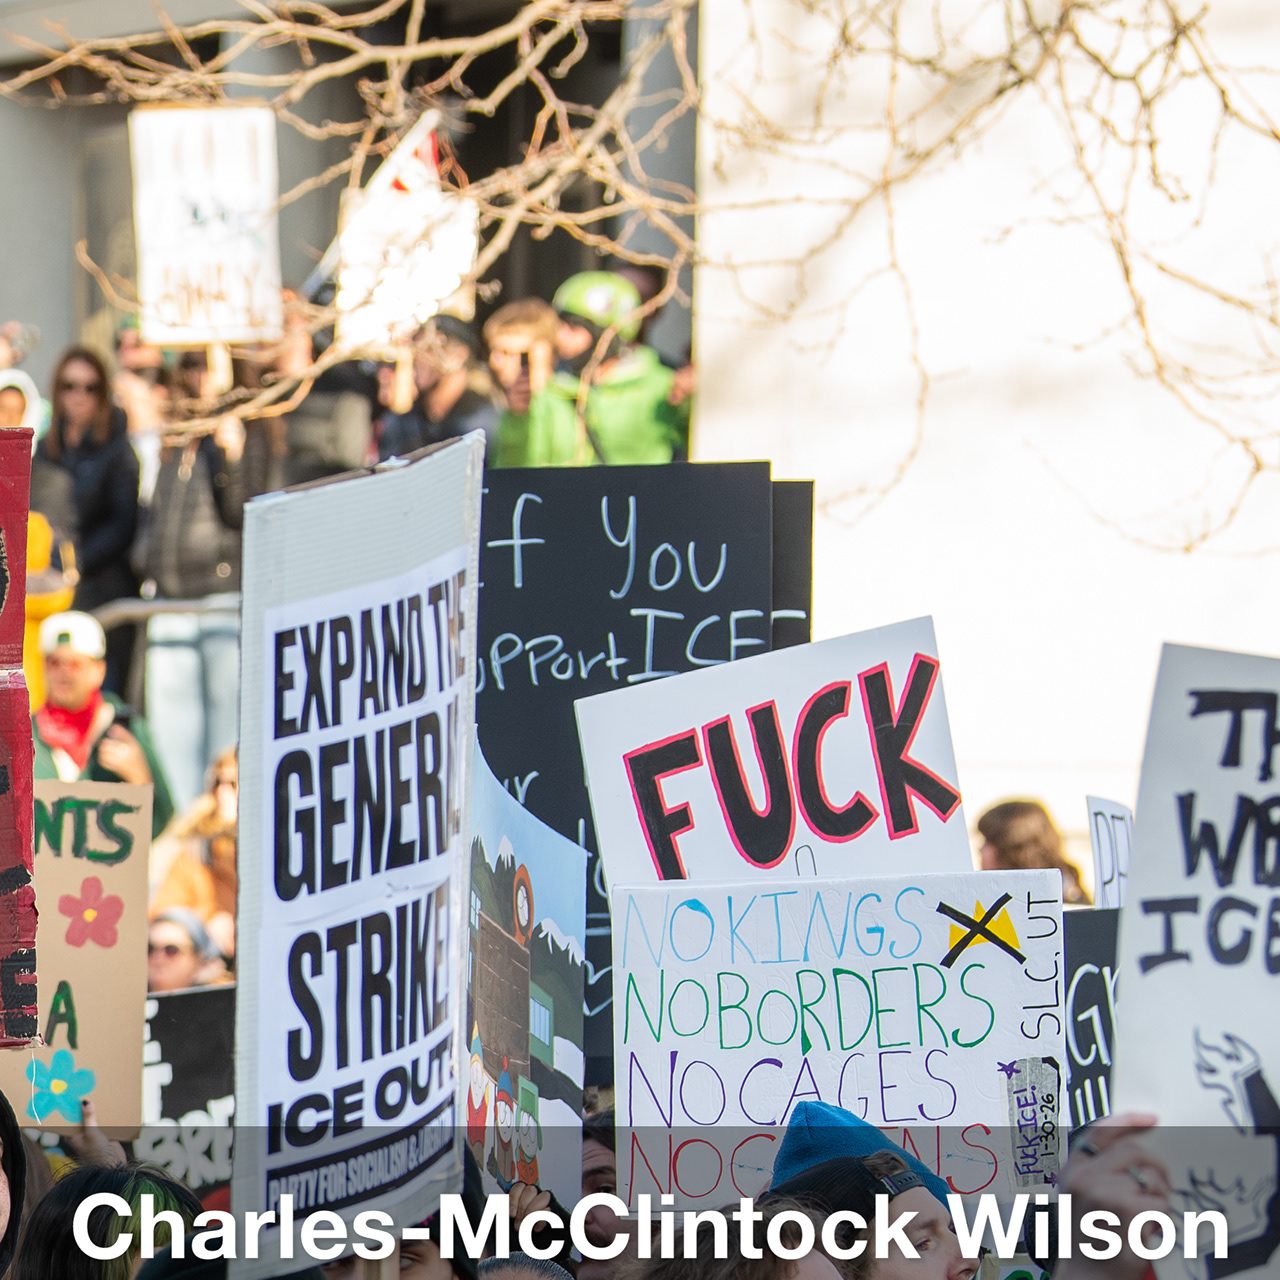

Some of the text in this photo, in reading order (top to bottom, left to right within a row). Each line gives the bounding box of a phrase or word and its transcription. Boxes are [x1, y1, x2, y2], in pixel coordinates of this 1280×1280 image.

[273, 593, 428, 741] EXPAND
[273, 692, 462, 903] GENER
[622, 652, 962, 881] FUCK
[726, 886, 926, 964] KINGS
[1026, 890, 1059, 940] UT
[286, 875, 451, 1083] STRIKE
[717, 963, 995, 1056] BORDERS
[267, 1079, 365, 1155] ICE
[738, 1048, 957, 1126] CAGES
[316, 1160, 348, 1203] FOR
